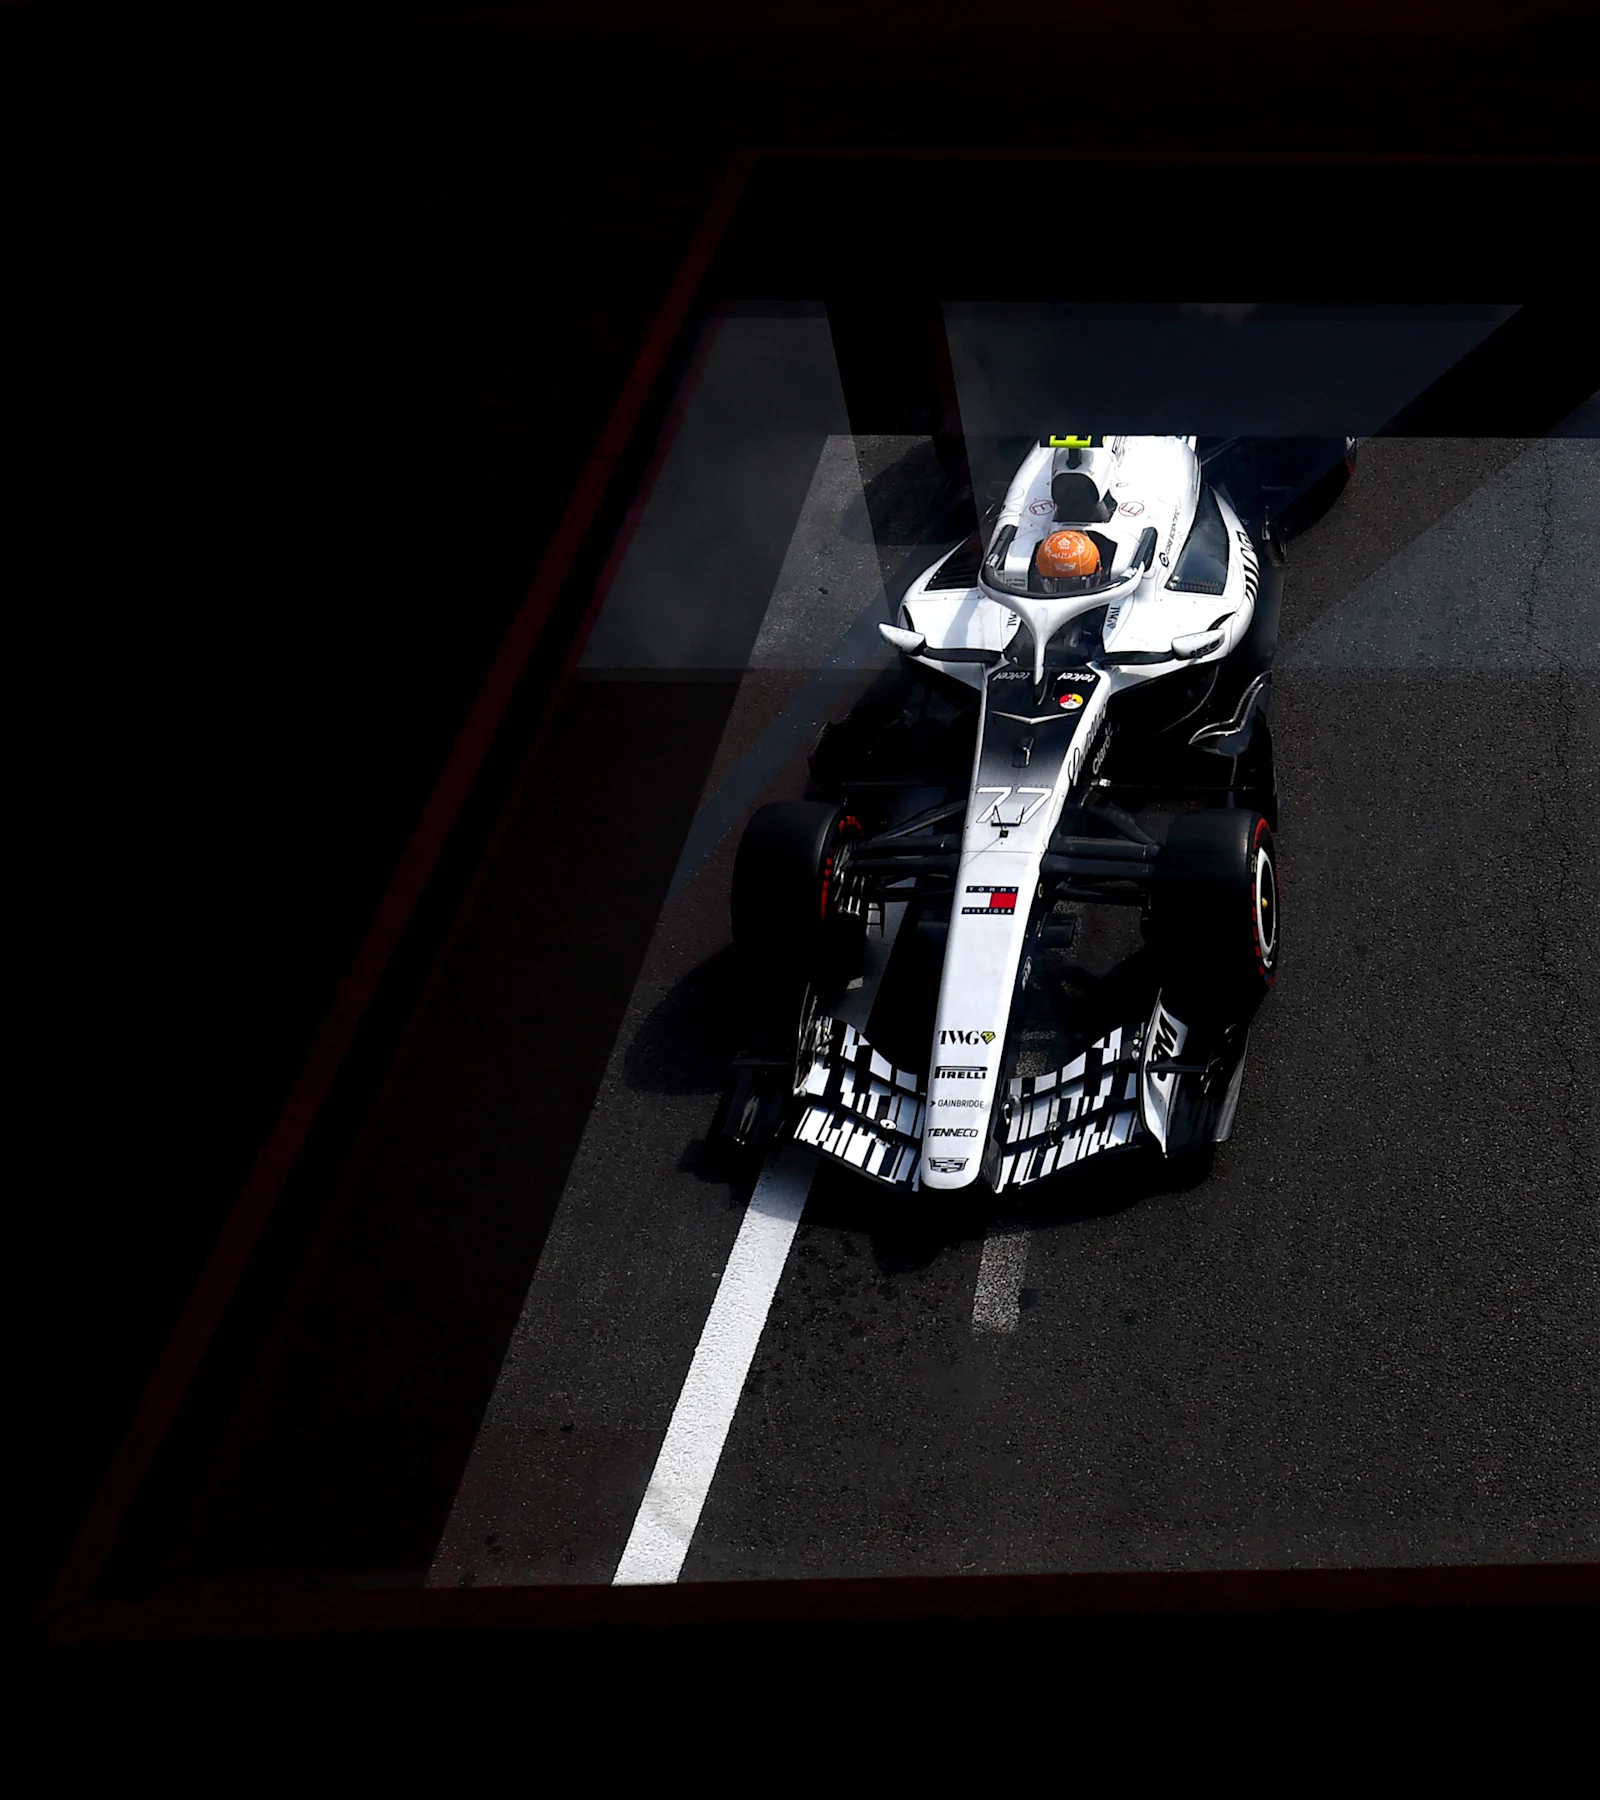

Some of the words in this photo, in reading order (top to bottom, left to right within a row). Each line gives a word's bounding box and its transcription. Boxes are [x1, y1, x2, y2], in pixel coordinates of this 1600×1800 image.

[991, 671, 1031, 682] telcel
[1056, 671, 1097, 684] telcel
[975, 786, 1054, 824] 77
[937, 1030, 980, 1045] TWG
[934, 1066, 988, 1080] PIRELLI
[937, 1099, 985, 1109] GAINBRIDGE
[927, 1128, 979, 1138] TENNECO
